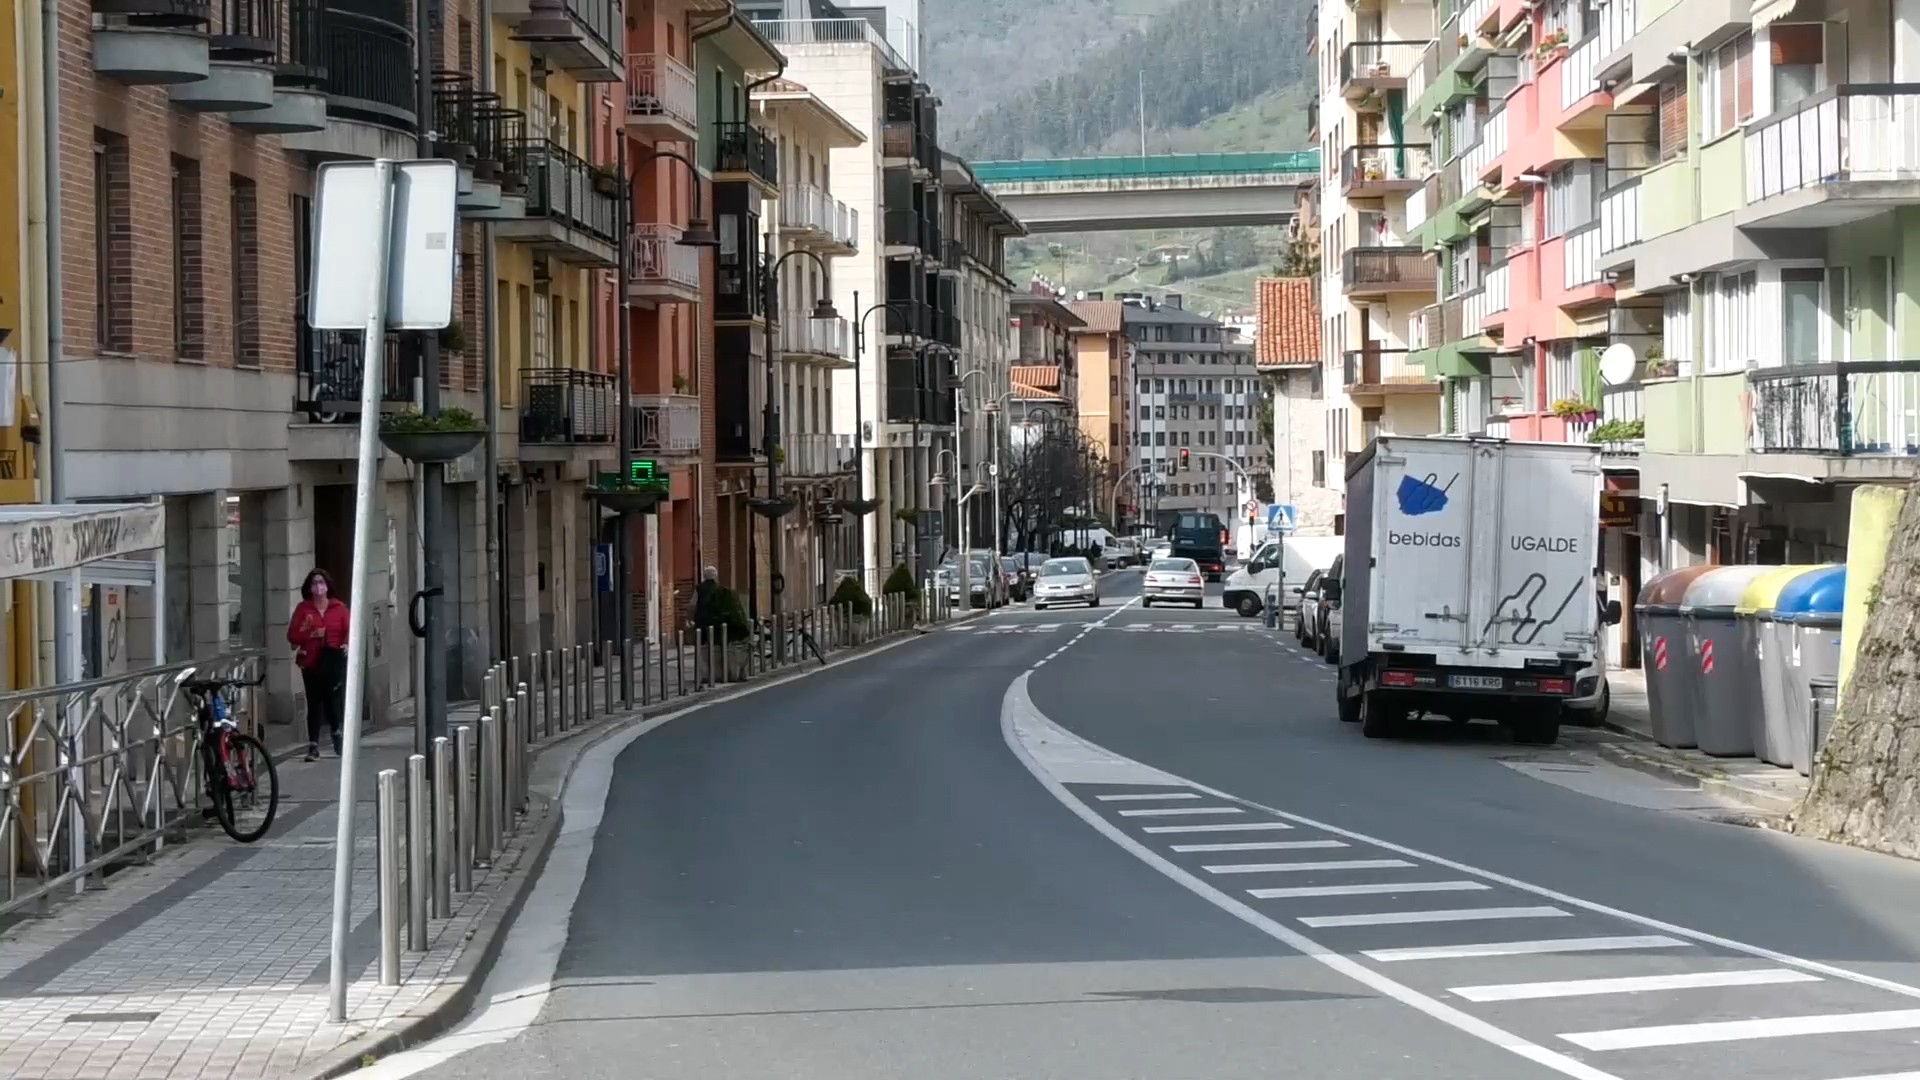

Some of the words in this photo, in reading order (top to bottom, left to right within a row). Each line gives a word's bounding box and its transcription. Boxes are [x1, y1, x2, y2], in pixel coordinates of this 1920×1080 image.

[31, 525, 55, 569] BAR
[1389, 530, 1461, 548] bebidas
[1511, 536, 1578, 553] UGALDE
